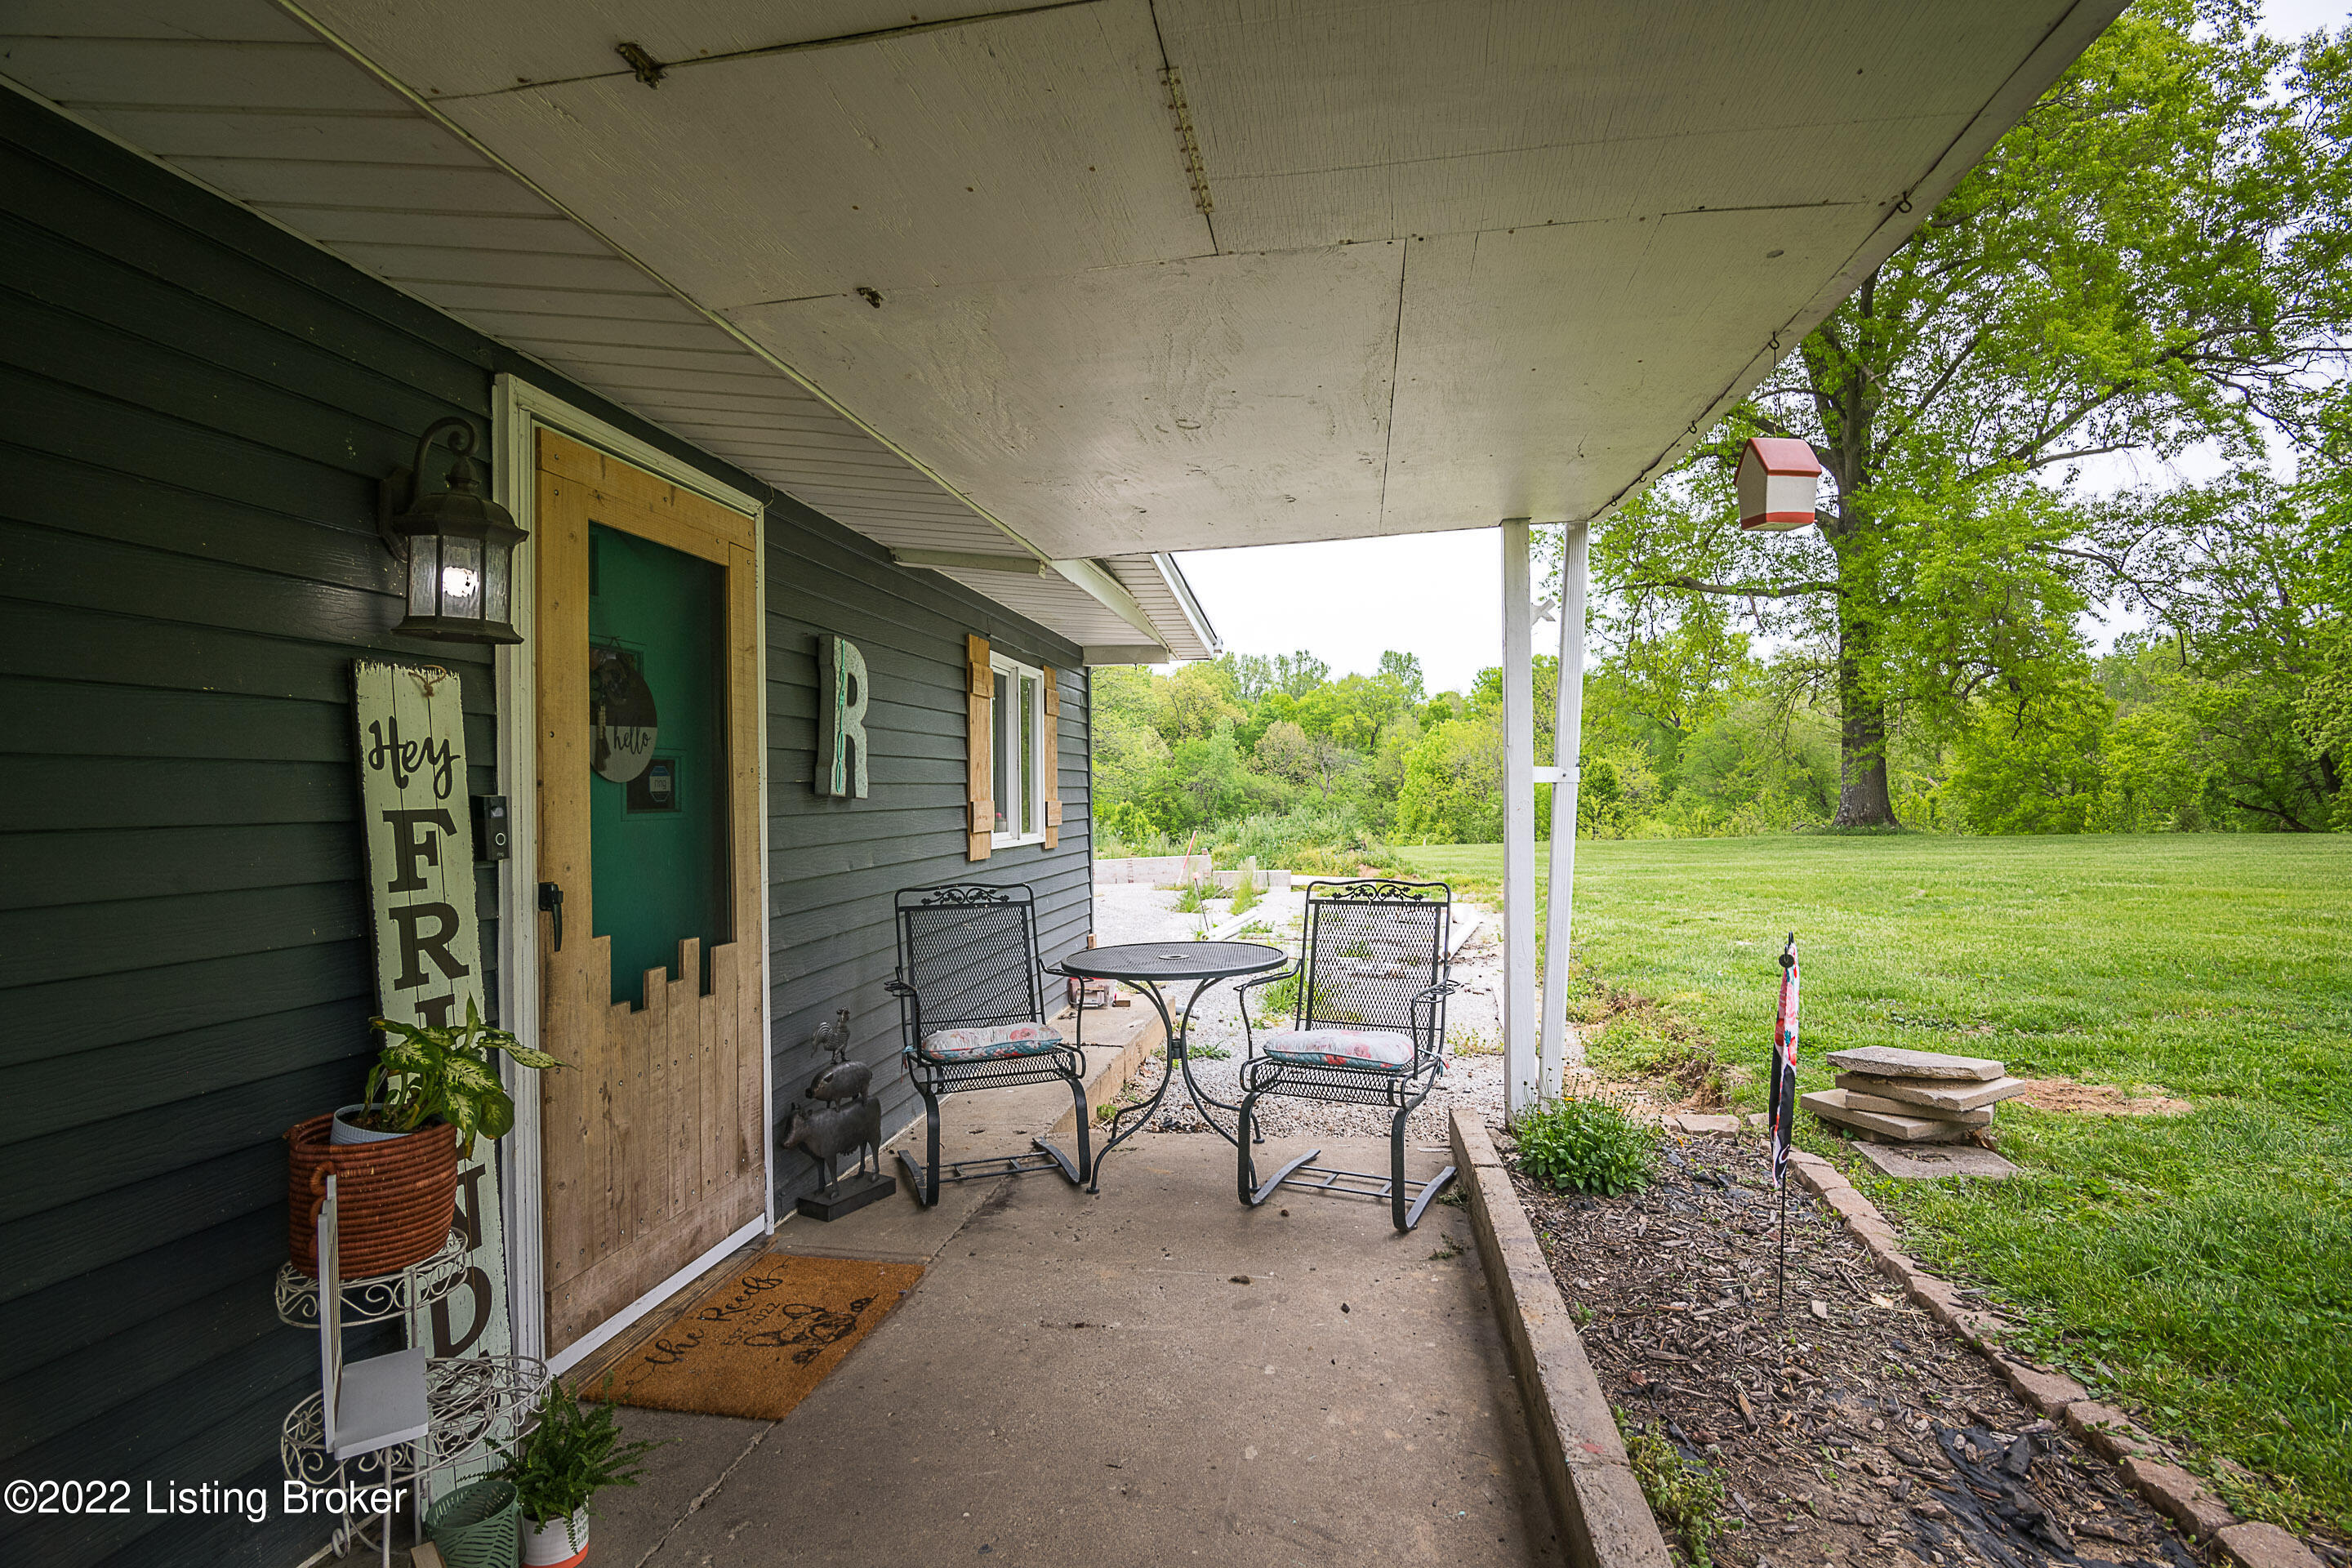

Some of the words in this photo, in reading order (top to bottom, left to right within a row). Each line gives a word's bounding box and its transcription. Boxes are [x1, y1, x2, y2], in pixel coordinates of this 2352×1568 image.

[613, 722, 652, 755] hello
[368, 715, 461, 800] Hey
[745, 1303, 781, 1325] 2022
